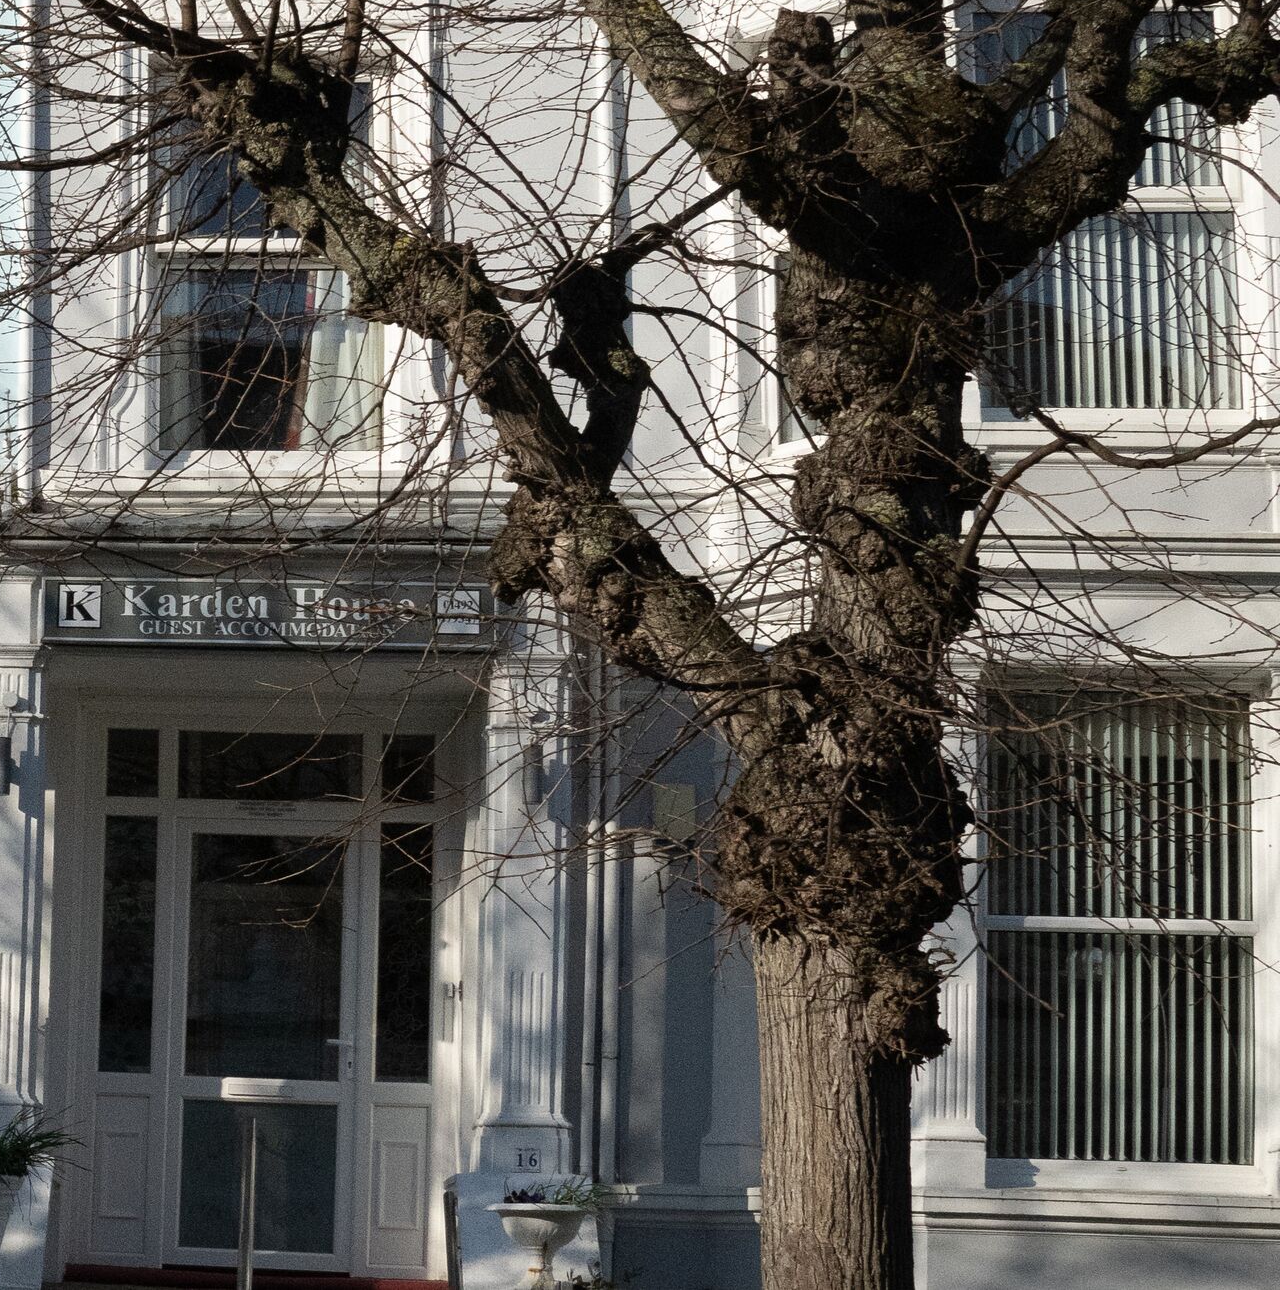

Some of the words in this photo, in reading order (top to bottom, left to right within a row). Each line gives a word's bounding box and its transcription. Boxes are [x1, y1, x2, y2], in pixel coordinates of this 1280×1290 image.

[62, 590, 97, 621] K
[120, 585, 269, 619] Karden
[292, 587, 416, 621] Houe
[139, 620, 205, 635] GUEST
[517, 1152, 538, 1168] 16
